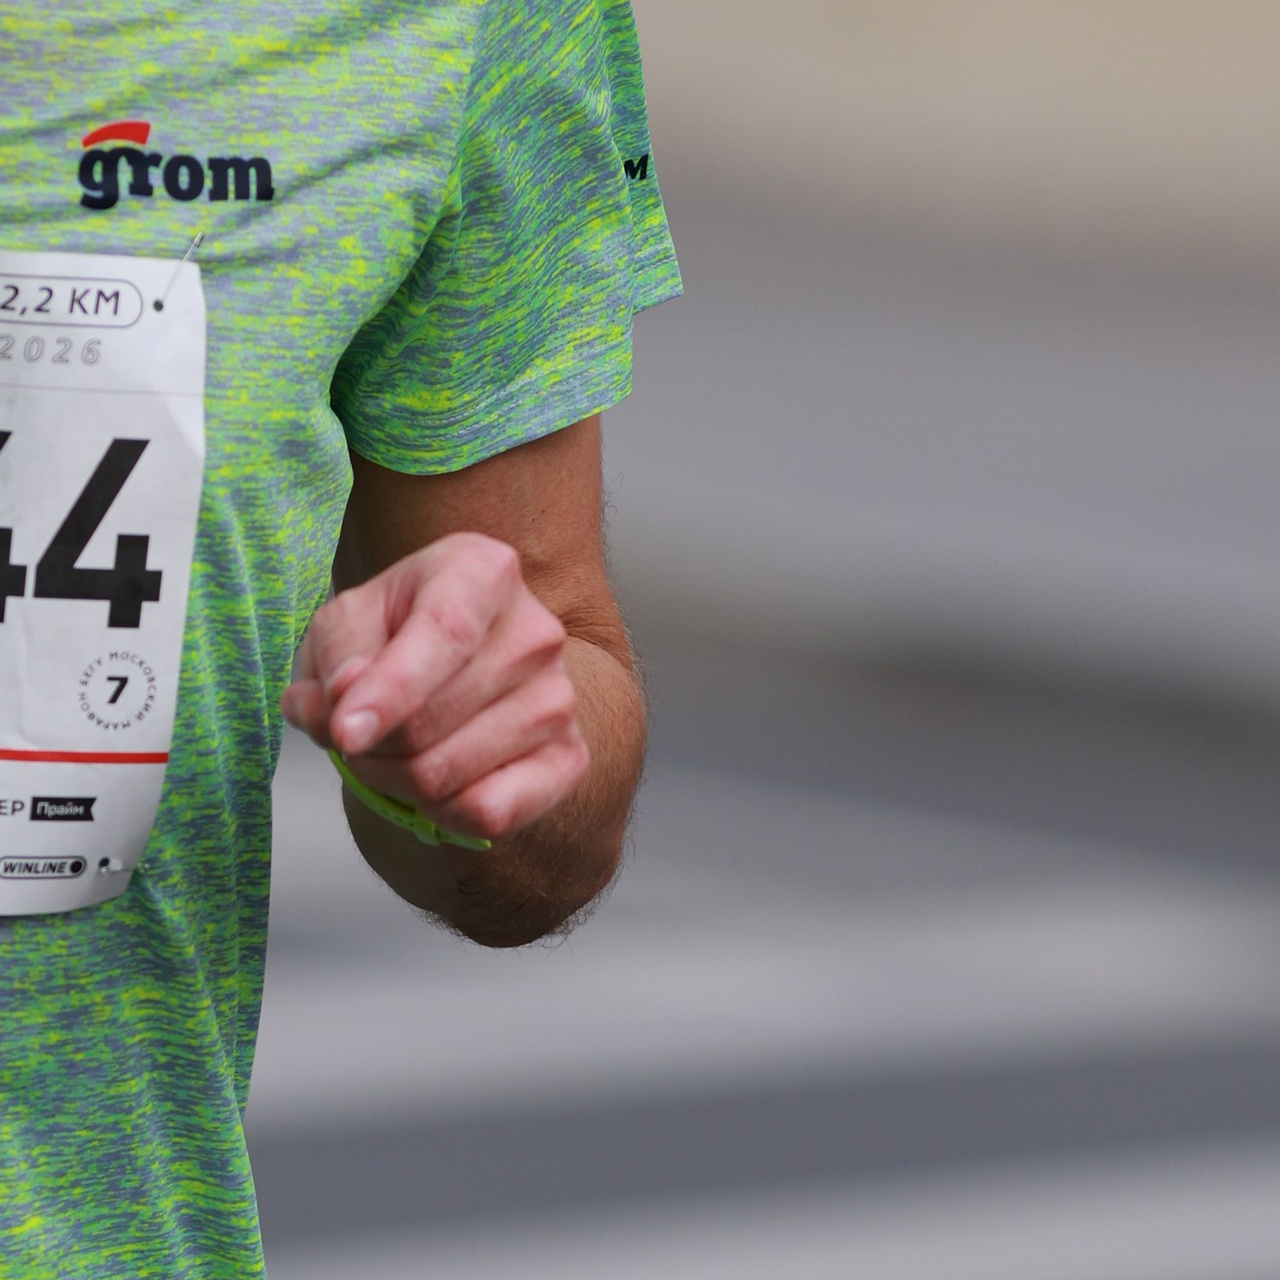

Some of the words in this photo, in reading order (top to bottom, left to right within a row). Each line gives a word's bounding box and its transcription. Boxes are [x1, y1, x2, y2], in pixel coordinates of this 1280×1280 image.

[78, 144, 275, 210] grom
[68, 287, 121, 316] КМ
[106, 675, 129, 705] 7
[36, 801, 86, 818] Прайм
[2, 862, 68, 874] WINLINE
